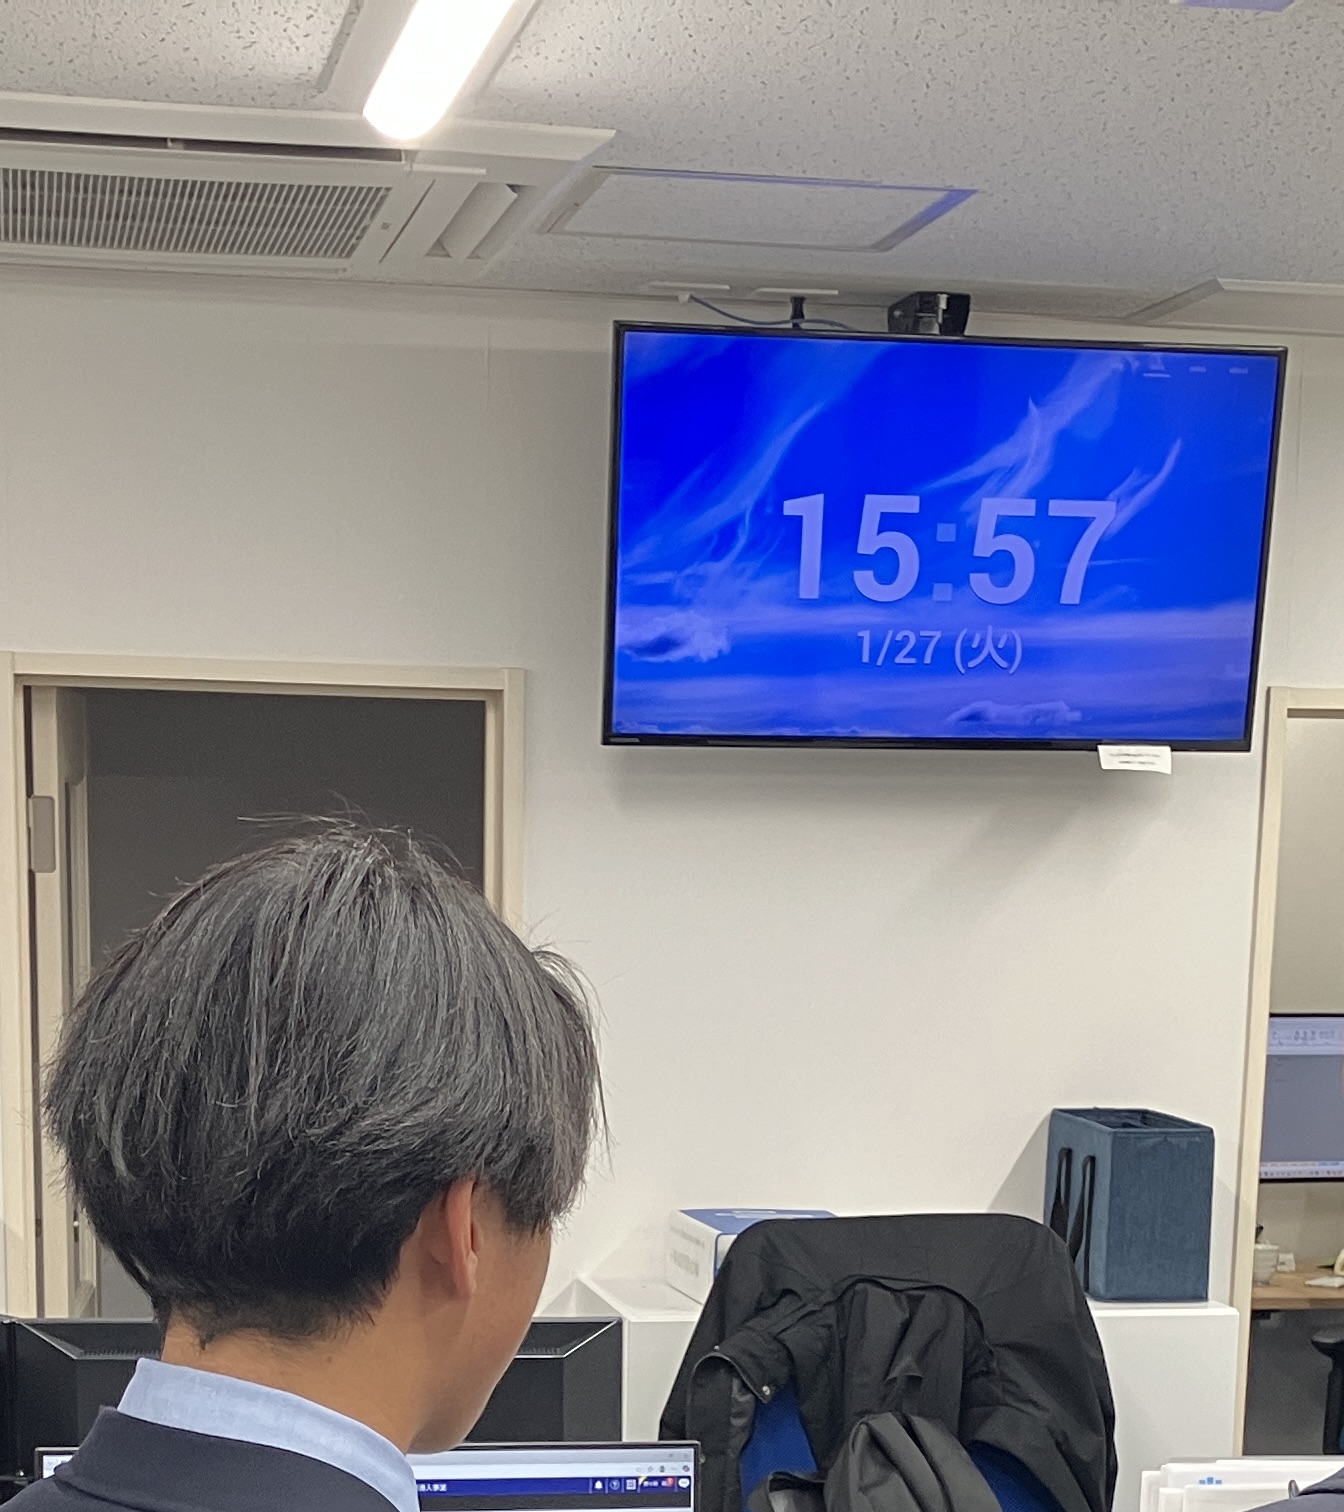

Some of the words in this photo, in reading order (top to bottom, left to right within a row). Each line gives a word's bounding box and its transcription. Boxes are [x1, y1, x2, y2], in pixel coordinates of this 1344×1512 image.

[782, 492, 1116, 605] 15:57
[857, 629, 943, 666] 1/27
[953, 625, 1024, 675] (火)
